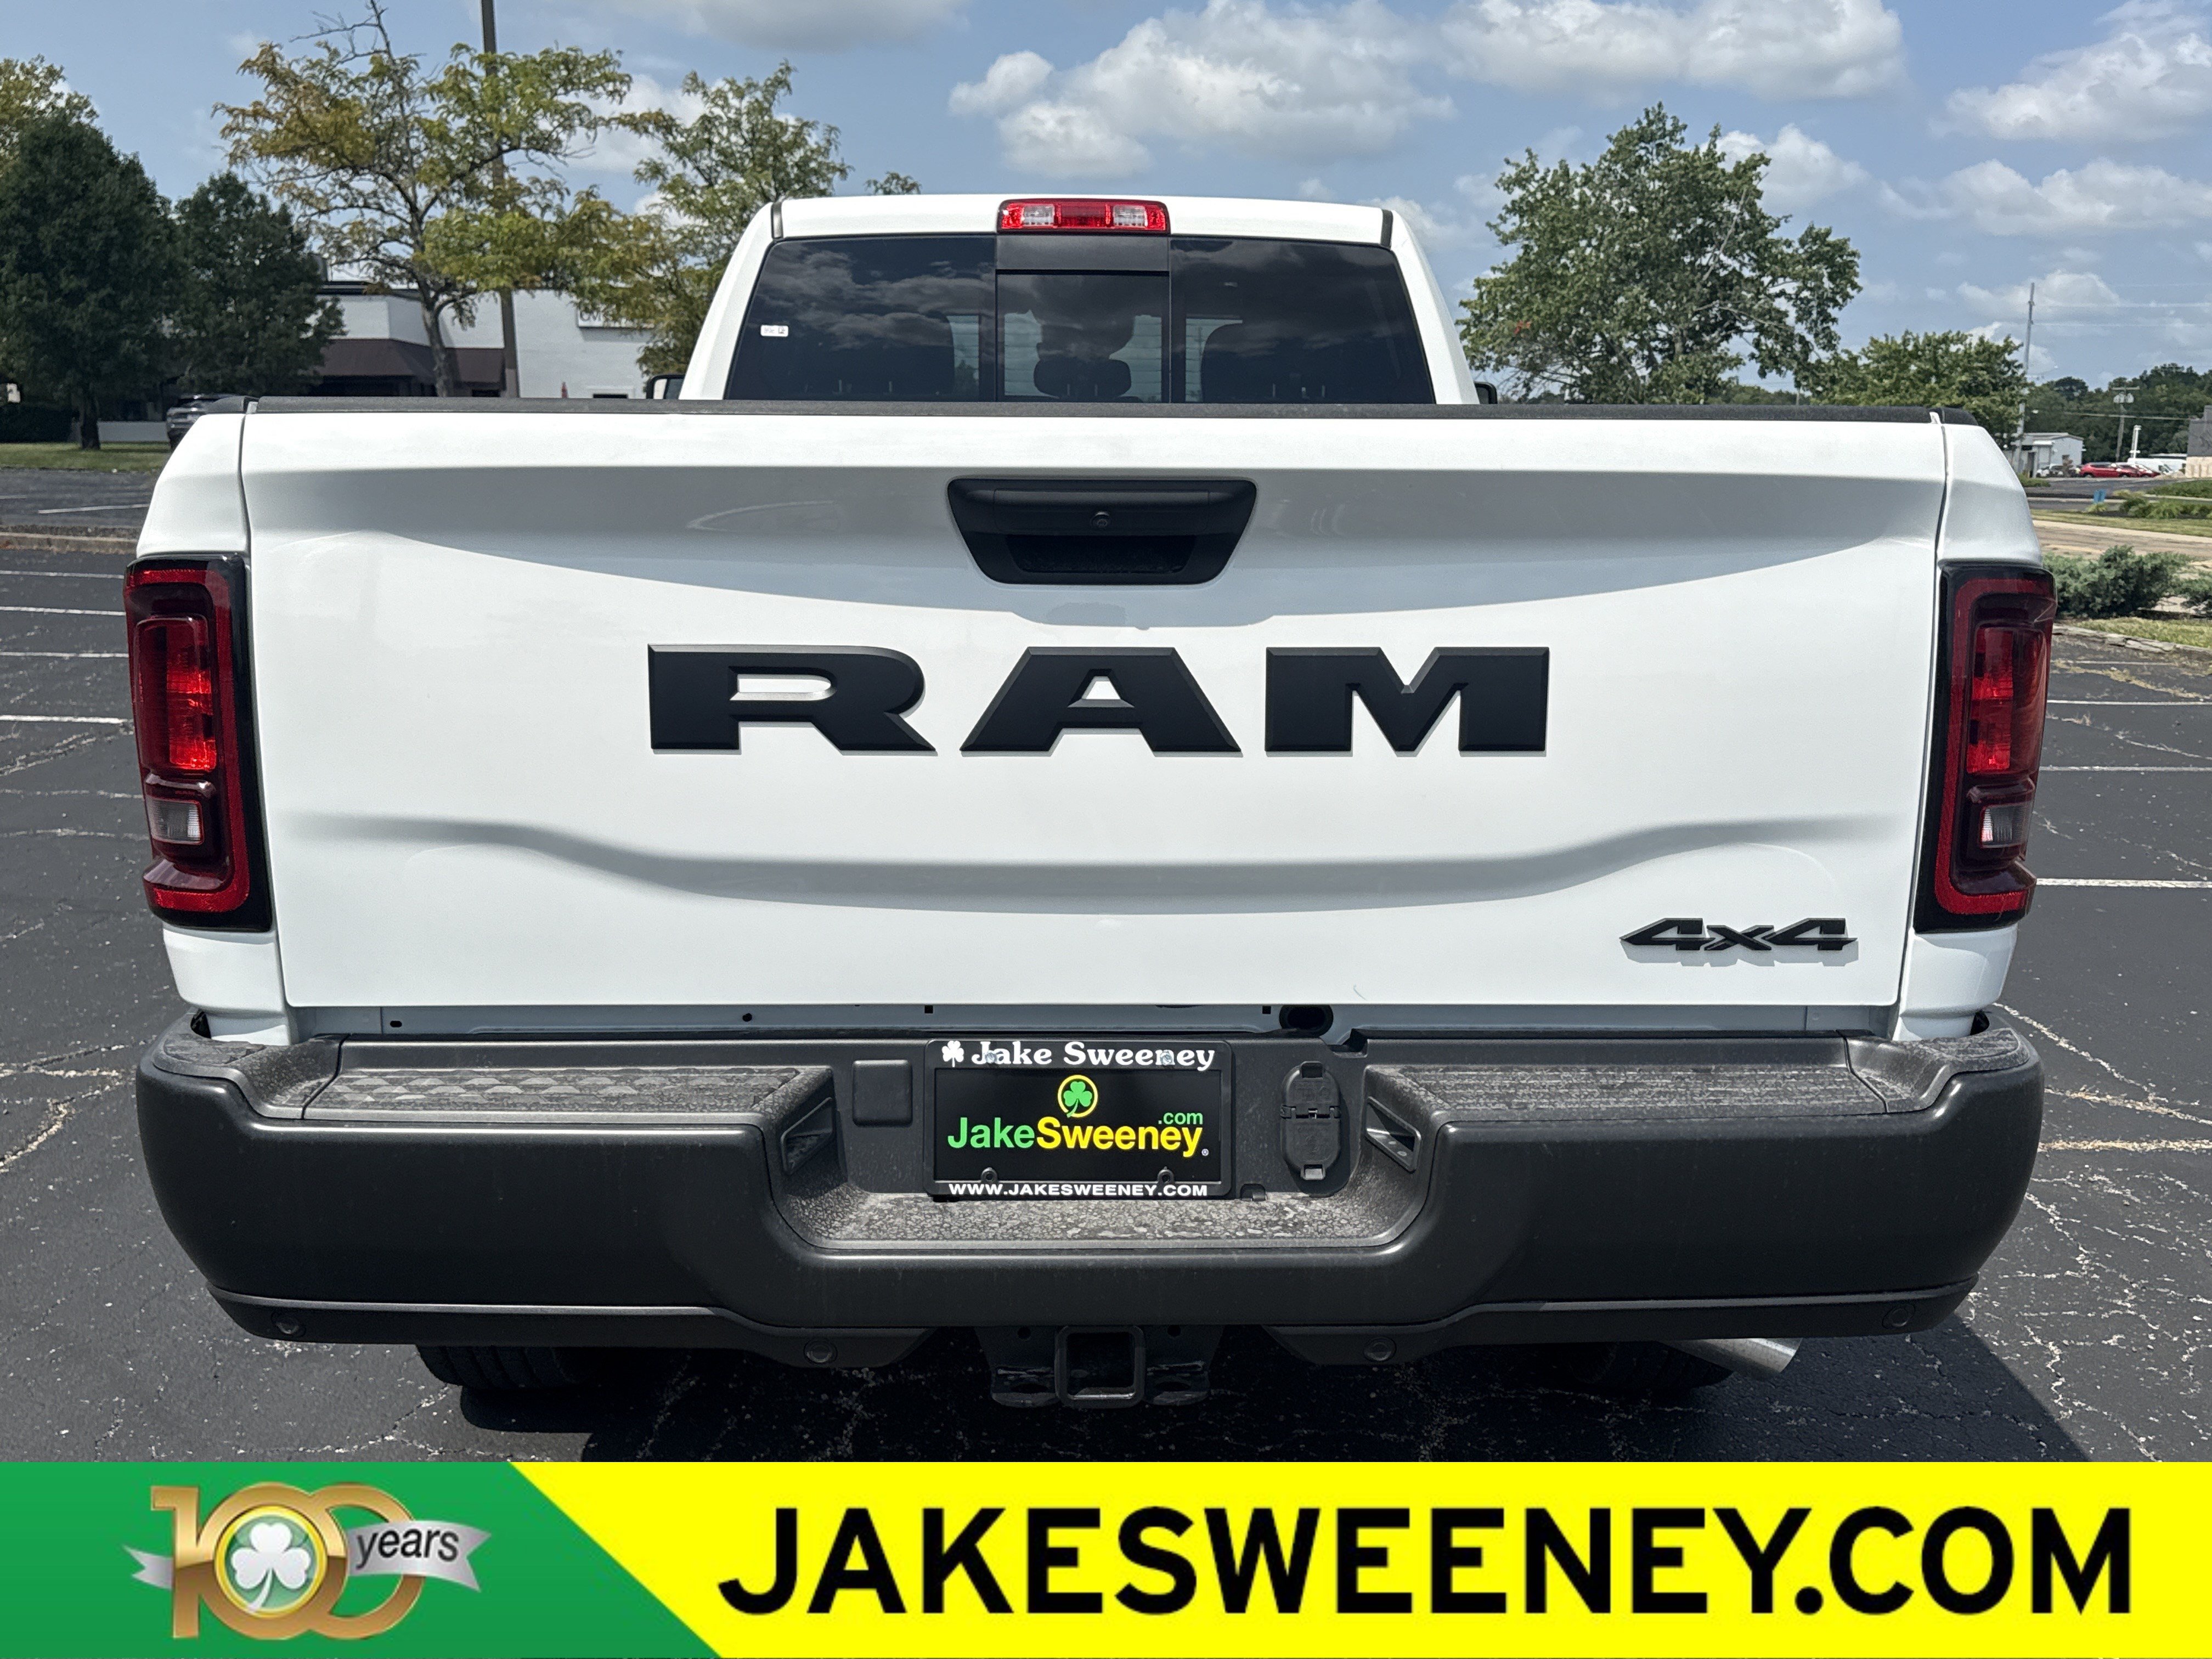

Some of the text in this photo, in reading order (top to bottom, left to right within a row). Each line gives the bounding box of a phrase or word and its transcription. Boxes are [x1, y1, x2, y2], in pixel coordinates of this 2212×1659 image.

[648, 644, 1550, 754] RAM
[971, 1040, 1215, 1071] Jake Sweeney
[949, 1183, 1208, 1197] WWW.JAKESWEENEY.COM
